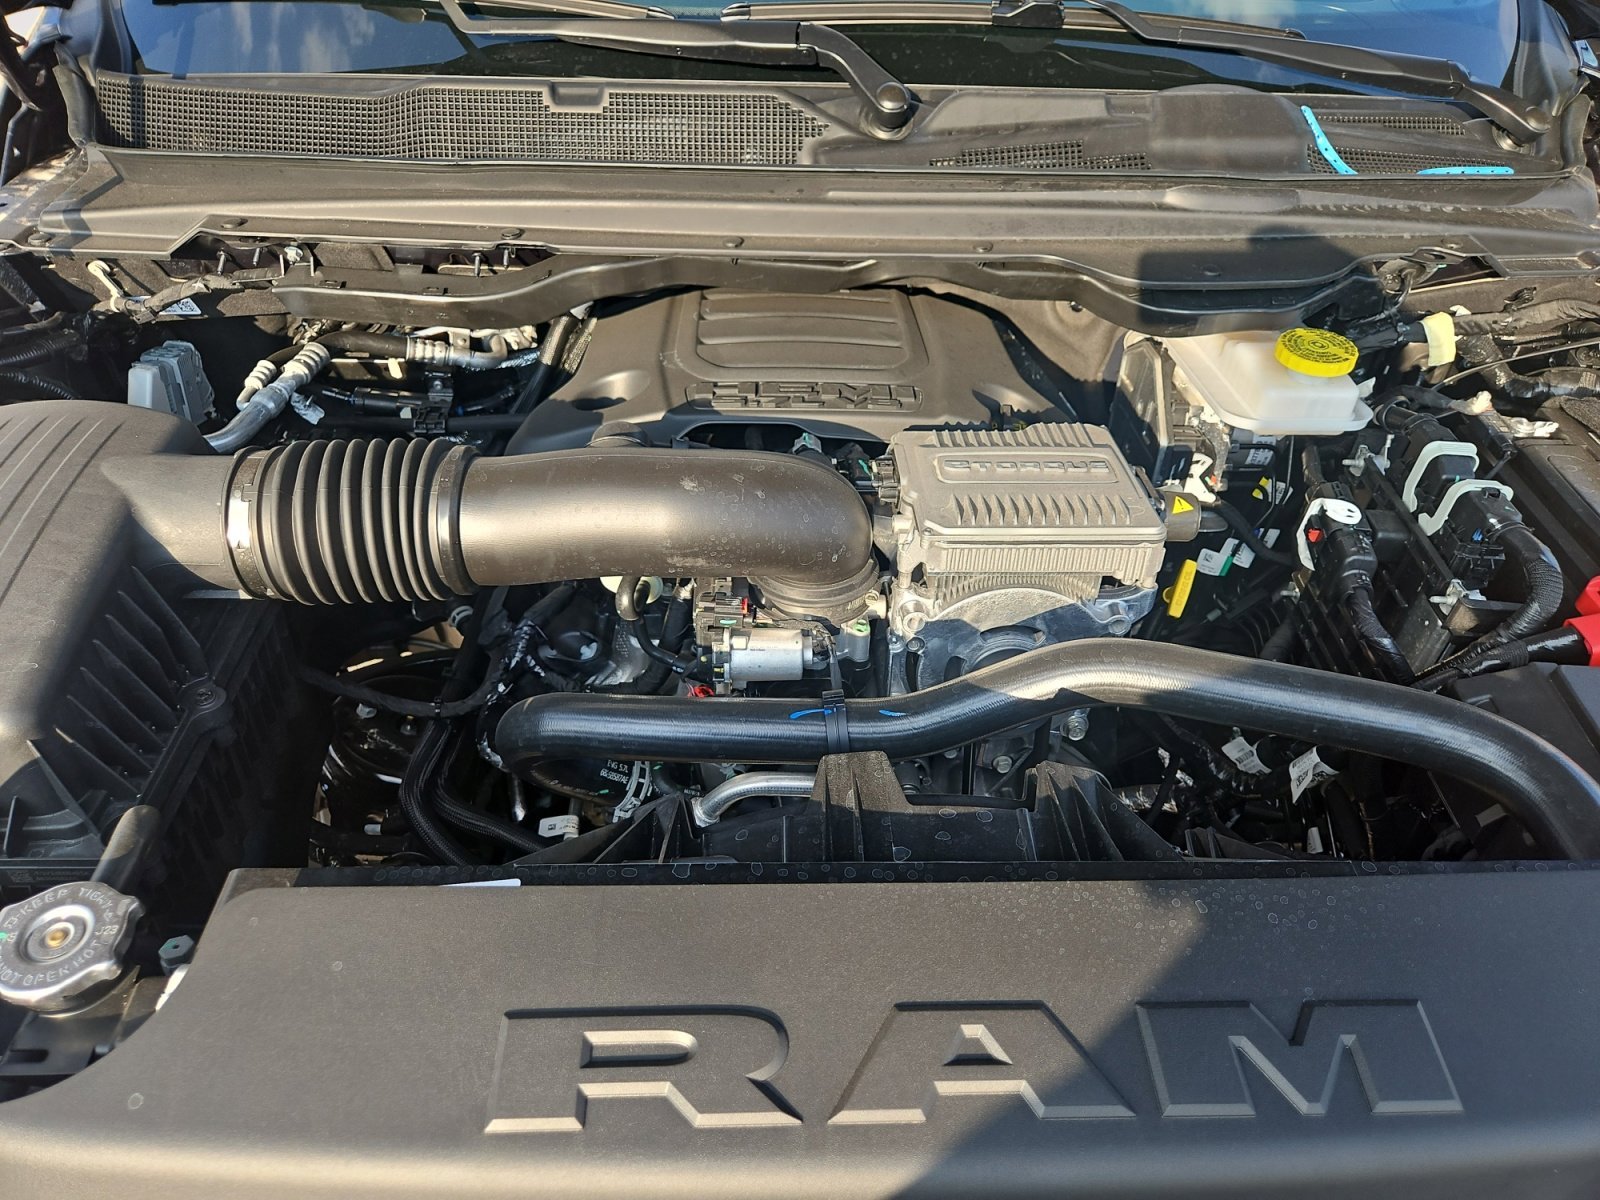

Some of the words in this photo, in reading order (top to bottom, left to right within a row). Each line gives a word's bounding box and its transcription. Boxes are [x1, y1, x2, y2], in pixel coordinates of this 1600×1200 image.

[695, 381, 917, 410] HEMI
[20, 888, 68, 915] KEEP
[95, 924, 119, 936] J23
[23, 963, 70, 986] OPEN
[72, 939, 98, 968] HOT
[484, 1001, 1464, 1133] RAM
